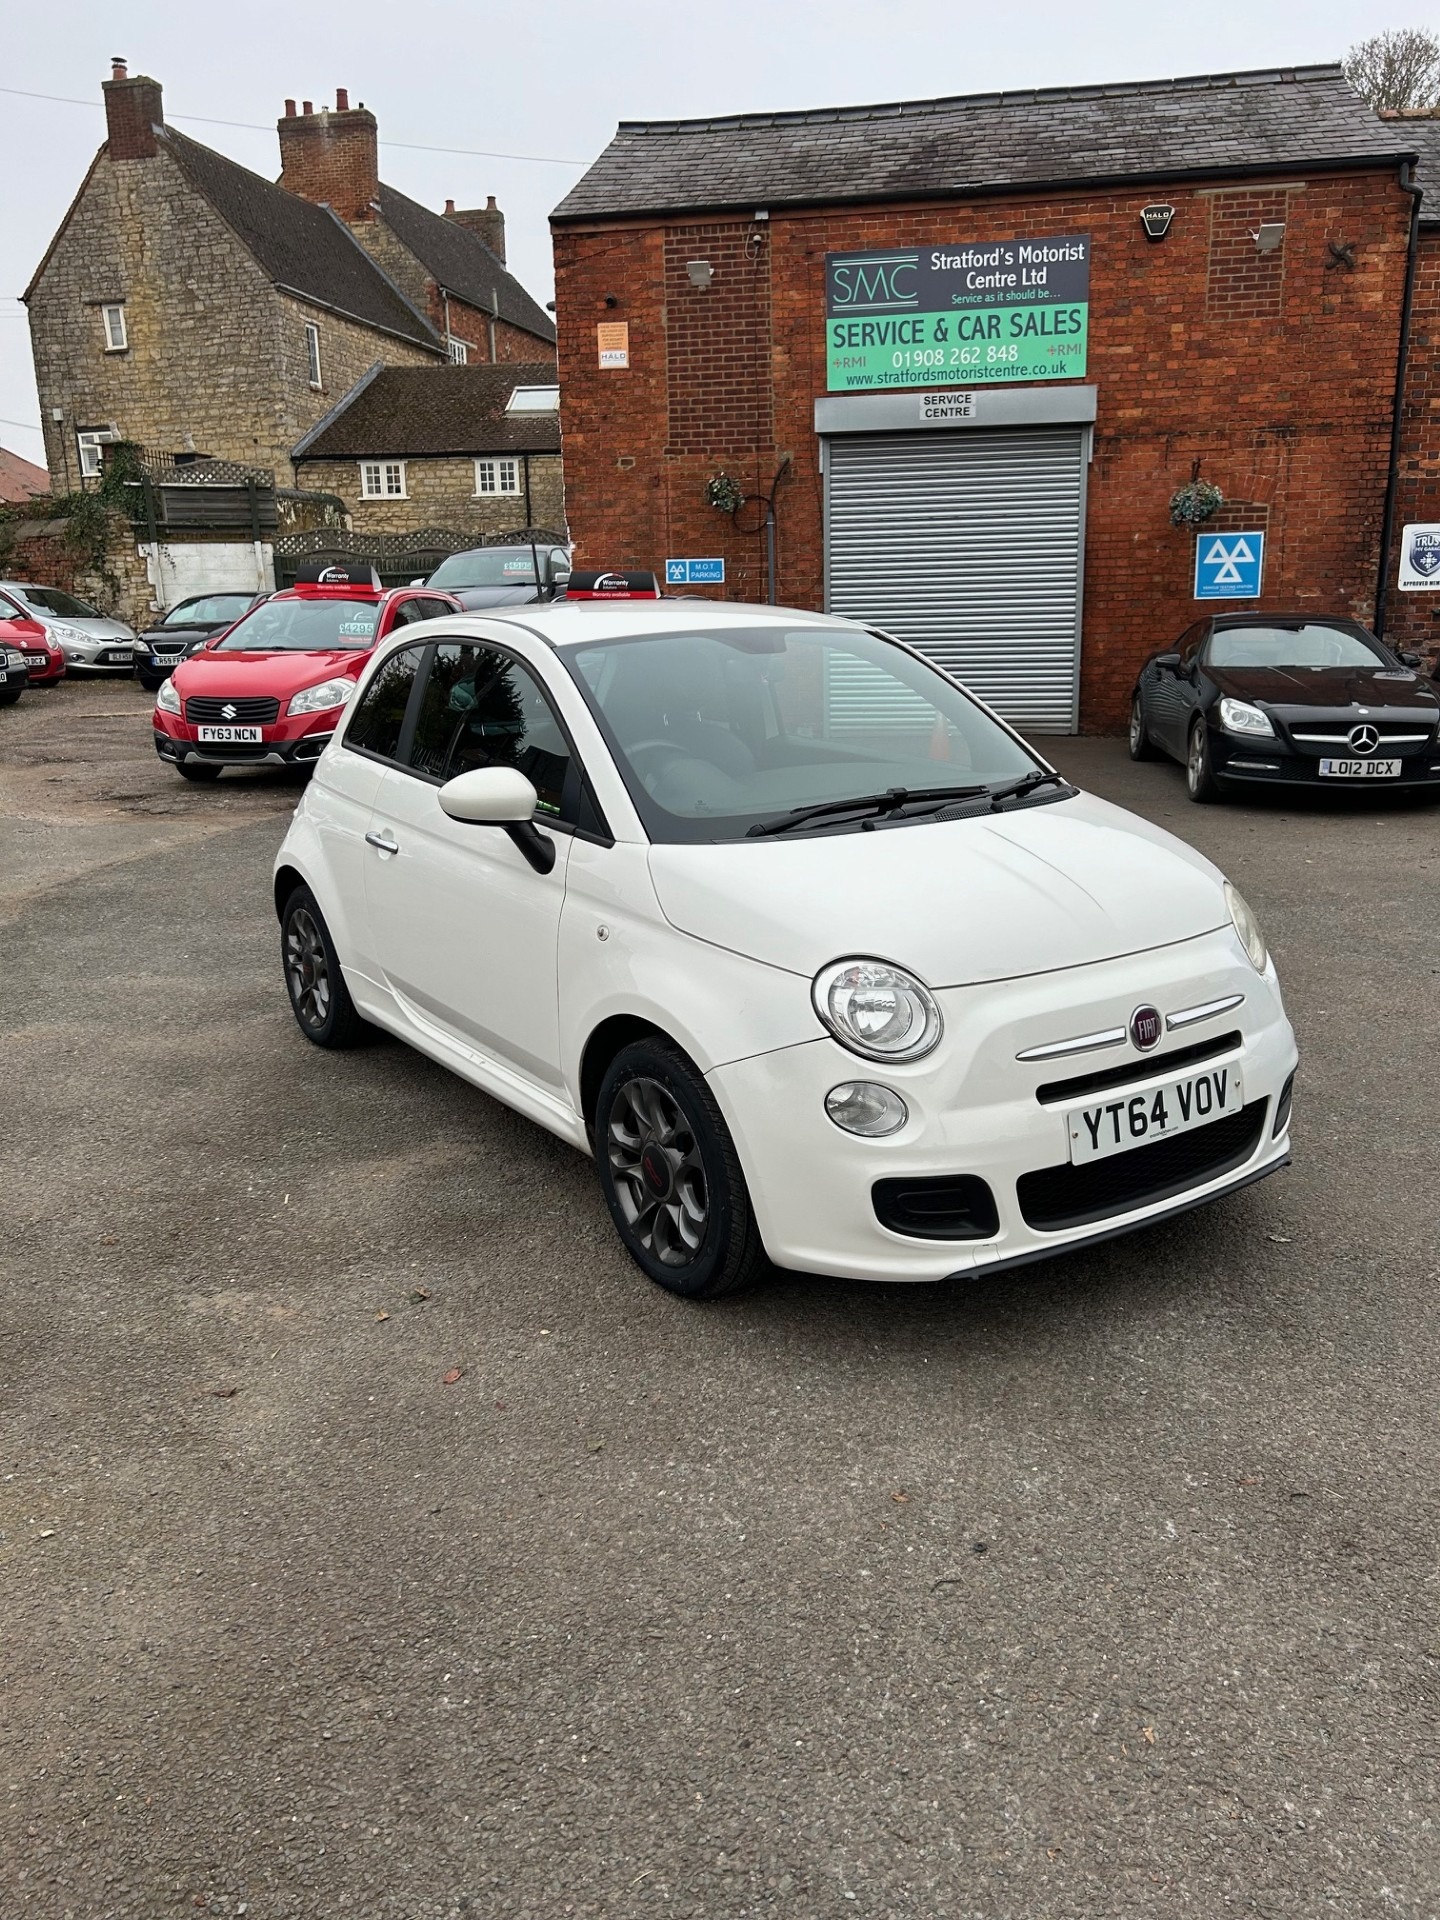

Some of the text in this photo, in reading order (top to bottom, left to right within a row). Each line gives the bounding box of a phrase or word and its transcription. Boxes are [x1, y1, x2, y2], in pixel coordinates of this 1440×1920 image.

[931, 243, 1085, 270] Stratford's Motorist
[833, 264, 918, 303] SMC
[966, 266, 1047, 289] Centre Ltd
[952, 292, 982, 304] Service
[985, 294, 995, 302] as
[997, 291, 1003, 301] it
[1006, 289, 1036, 301] should
[833, 308, 1082, 348] SERVICE & CAR SALES
[892, 345, 1018, 368] 01908 262 848
[846, 361, 1067, 386] www.stratfordsmotoristcentre.co.uk
[923, 394, 972, 405] SERVICE
[925, 407, 970, 418] CENTRE
[1416, 535, 1440, 547] TRUS
[326, 572, 349, 580] Warranty
[602, 579, 629, 587] Warranty
[340, 623, 373, 634] £4295
[203, 728, 257, 740] FY63 NCN
[1366, 761, 1394, 775] DCX
[1138, 1017, 1156, 1040] FIAT
[1083, 1069, 1227, 1150] YT64 VOV
